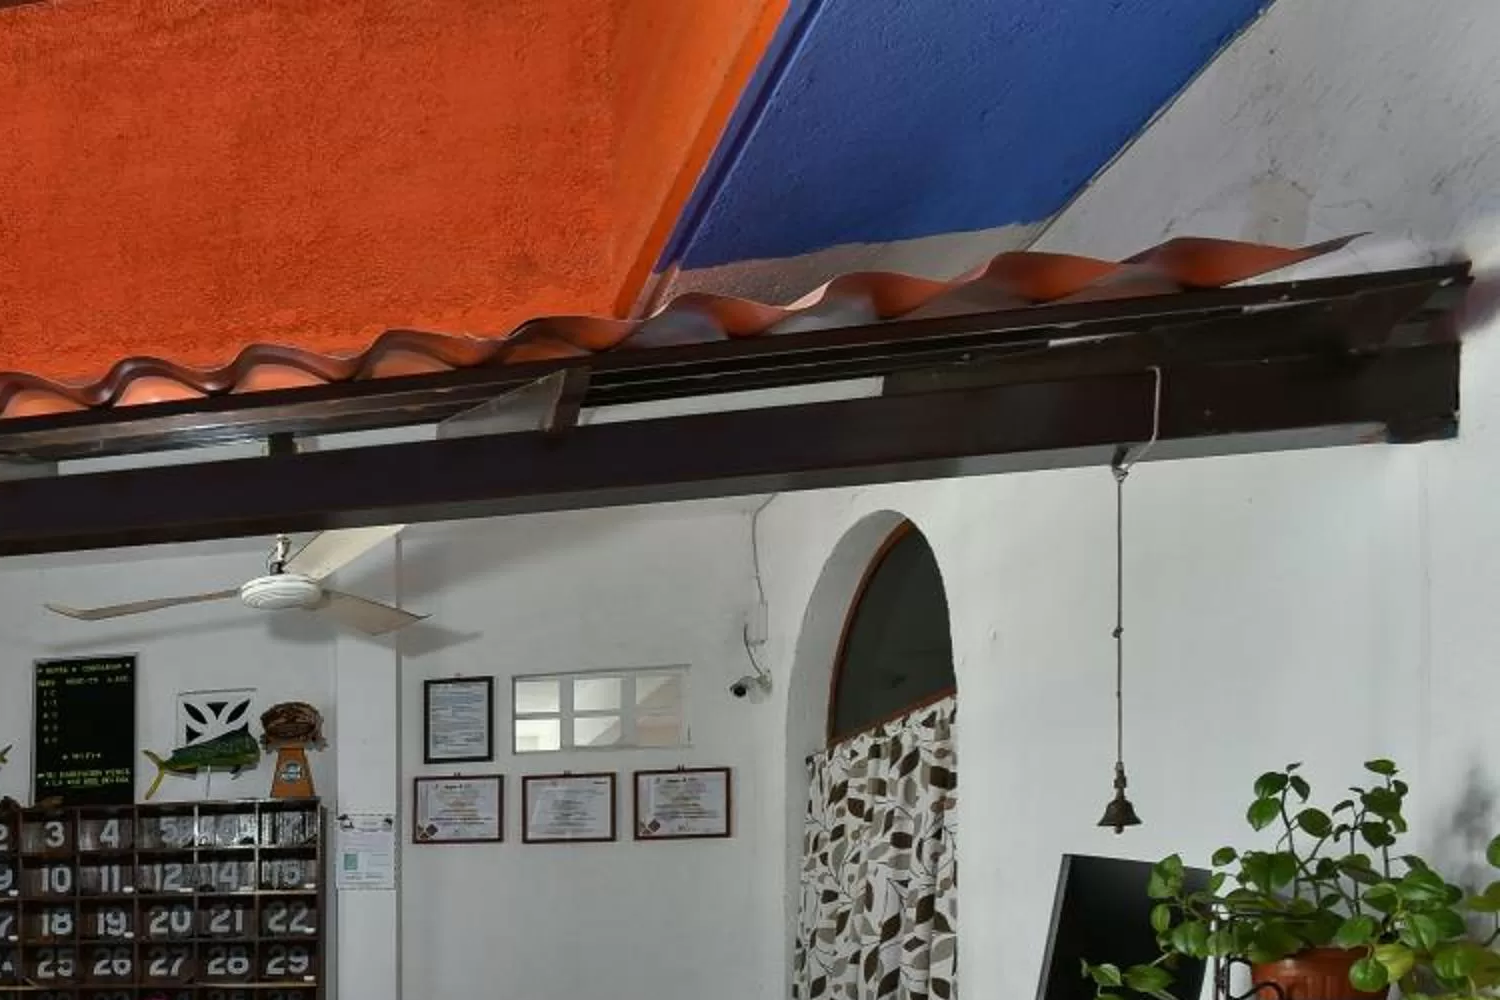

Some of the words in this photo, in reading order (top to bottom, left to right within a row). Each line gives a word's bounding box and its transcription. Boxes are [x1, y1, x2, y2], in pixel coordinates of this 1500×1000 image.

[45, 821, 65, 848] 3
[100, 818, 119, 849] 4
[160, 817, 177, 844] 5
[42, 865, 71, 893] 10
[101, 864, 119, 893] 11
[153, 863, 183, 890] 12
[210, 862, 239, 890] 14
[42, 907, 73, 936] 18
[97, 907, 127, 938] 19
[149, 905, 192, 934] 20
[209, 904, 243, 932] 21
[267, 901, 309, 933] 22
[37, 949, 75, 978] 25
[93, 947, 132, 978] 26
[149, 947, 187, 977] 27
[207, 946, 249, 975] 28
[266, 945, 309, 975] 29
